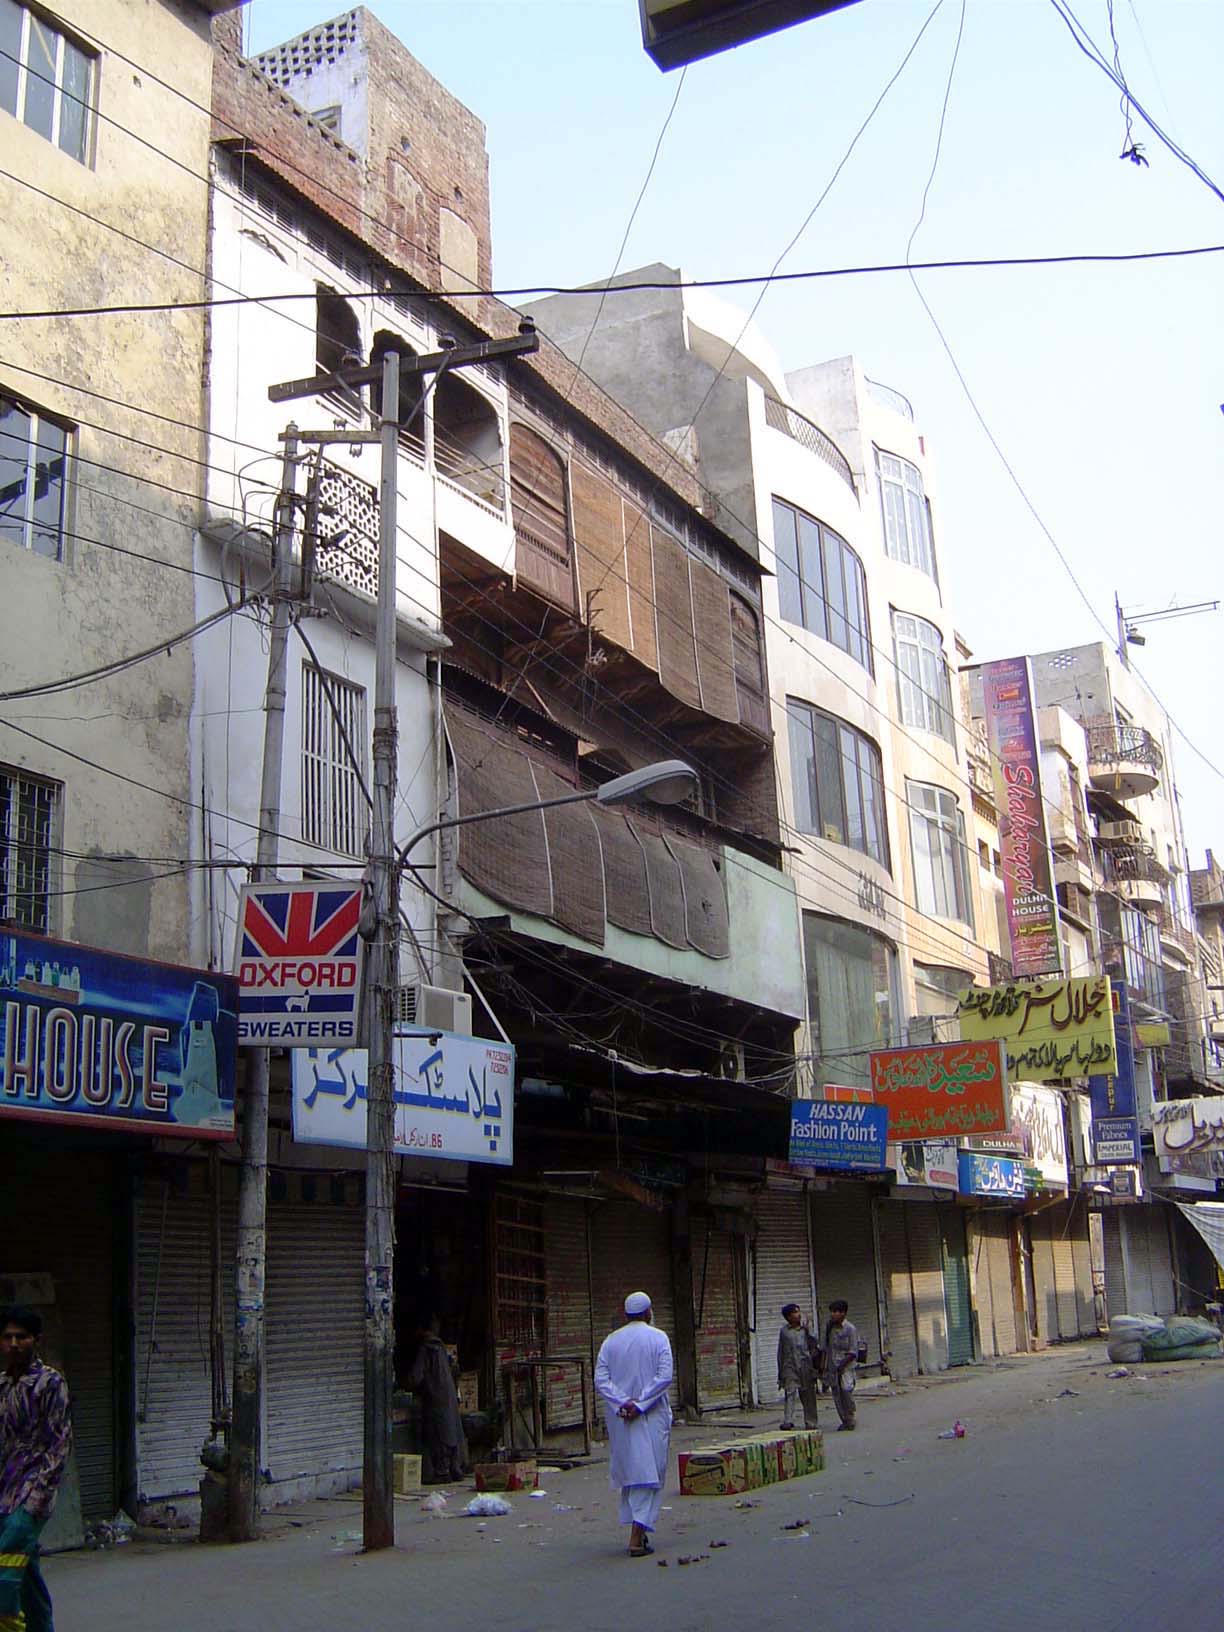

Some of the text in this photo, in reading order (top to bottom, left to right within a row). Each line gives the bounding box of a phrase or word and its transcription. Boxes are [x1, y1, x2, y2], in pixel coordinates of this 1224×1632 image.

[1012, 904, 1049, 917] HOUSE
[239, 962, 357, 988] OXFORD
[237, 1020, 354, 1038] SWEATERS
[4, 1001, 170, 1113] HOUSE
[303, 1047, 369, 1109] رکز
[809, 1103, 866, 1121] HASSAN
[790, 1118, 877, 1142] Fashion Point
[1098, 1121, 1132, 1131] Premium
[983, 1139, 1015, 1148] DULHA
